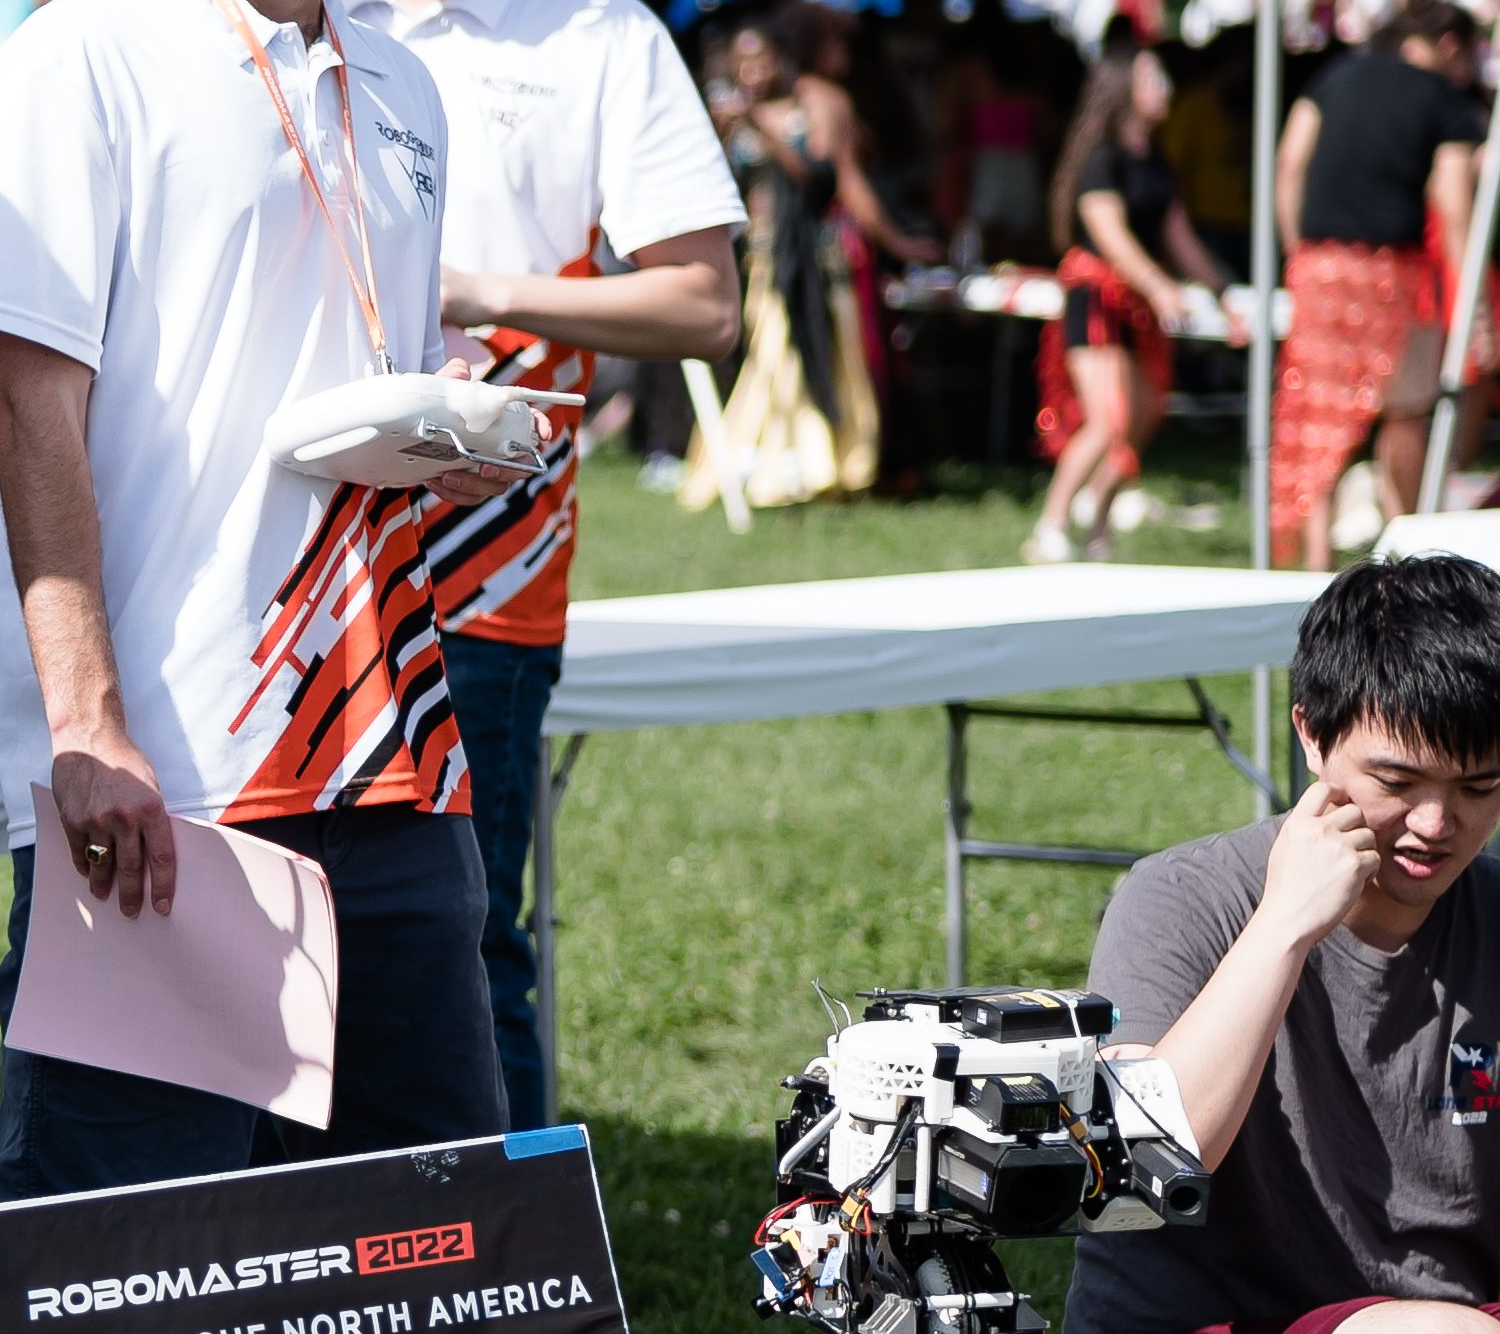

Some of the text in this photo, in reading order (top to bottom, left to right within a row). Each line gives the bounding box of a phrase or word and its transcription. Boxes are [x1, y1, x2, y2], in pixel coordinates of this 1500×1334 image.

[27, 1227, 467, 1322] ROBOMASTER 2022
[427, 1274, 593, 1328] AMERICA
